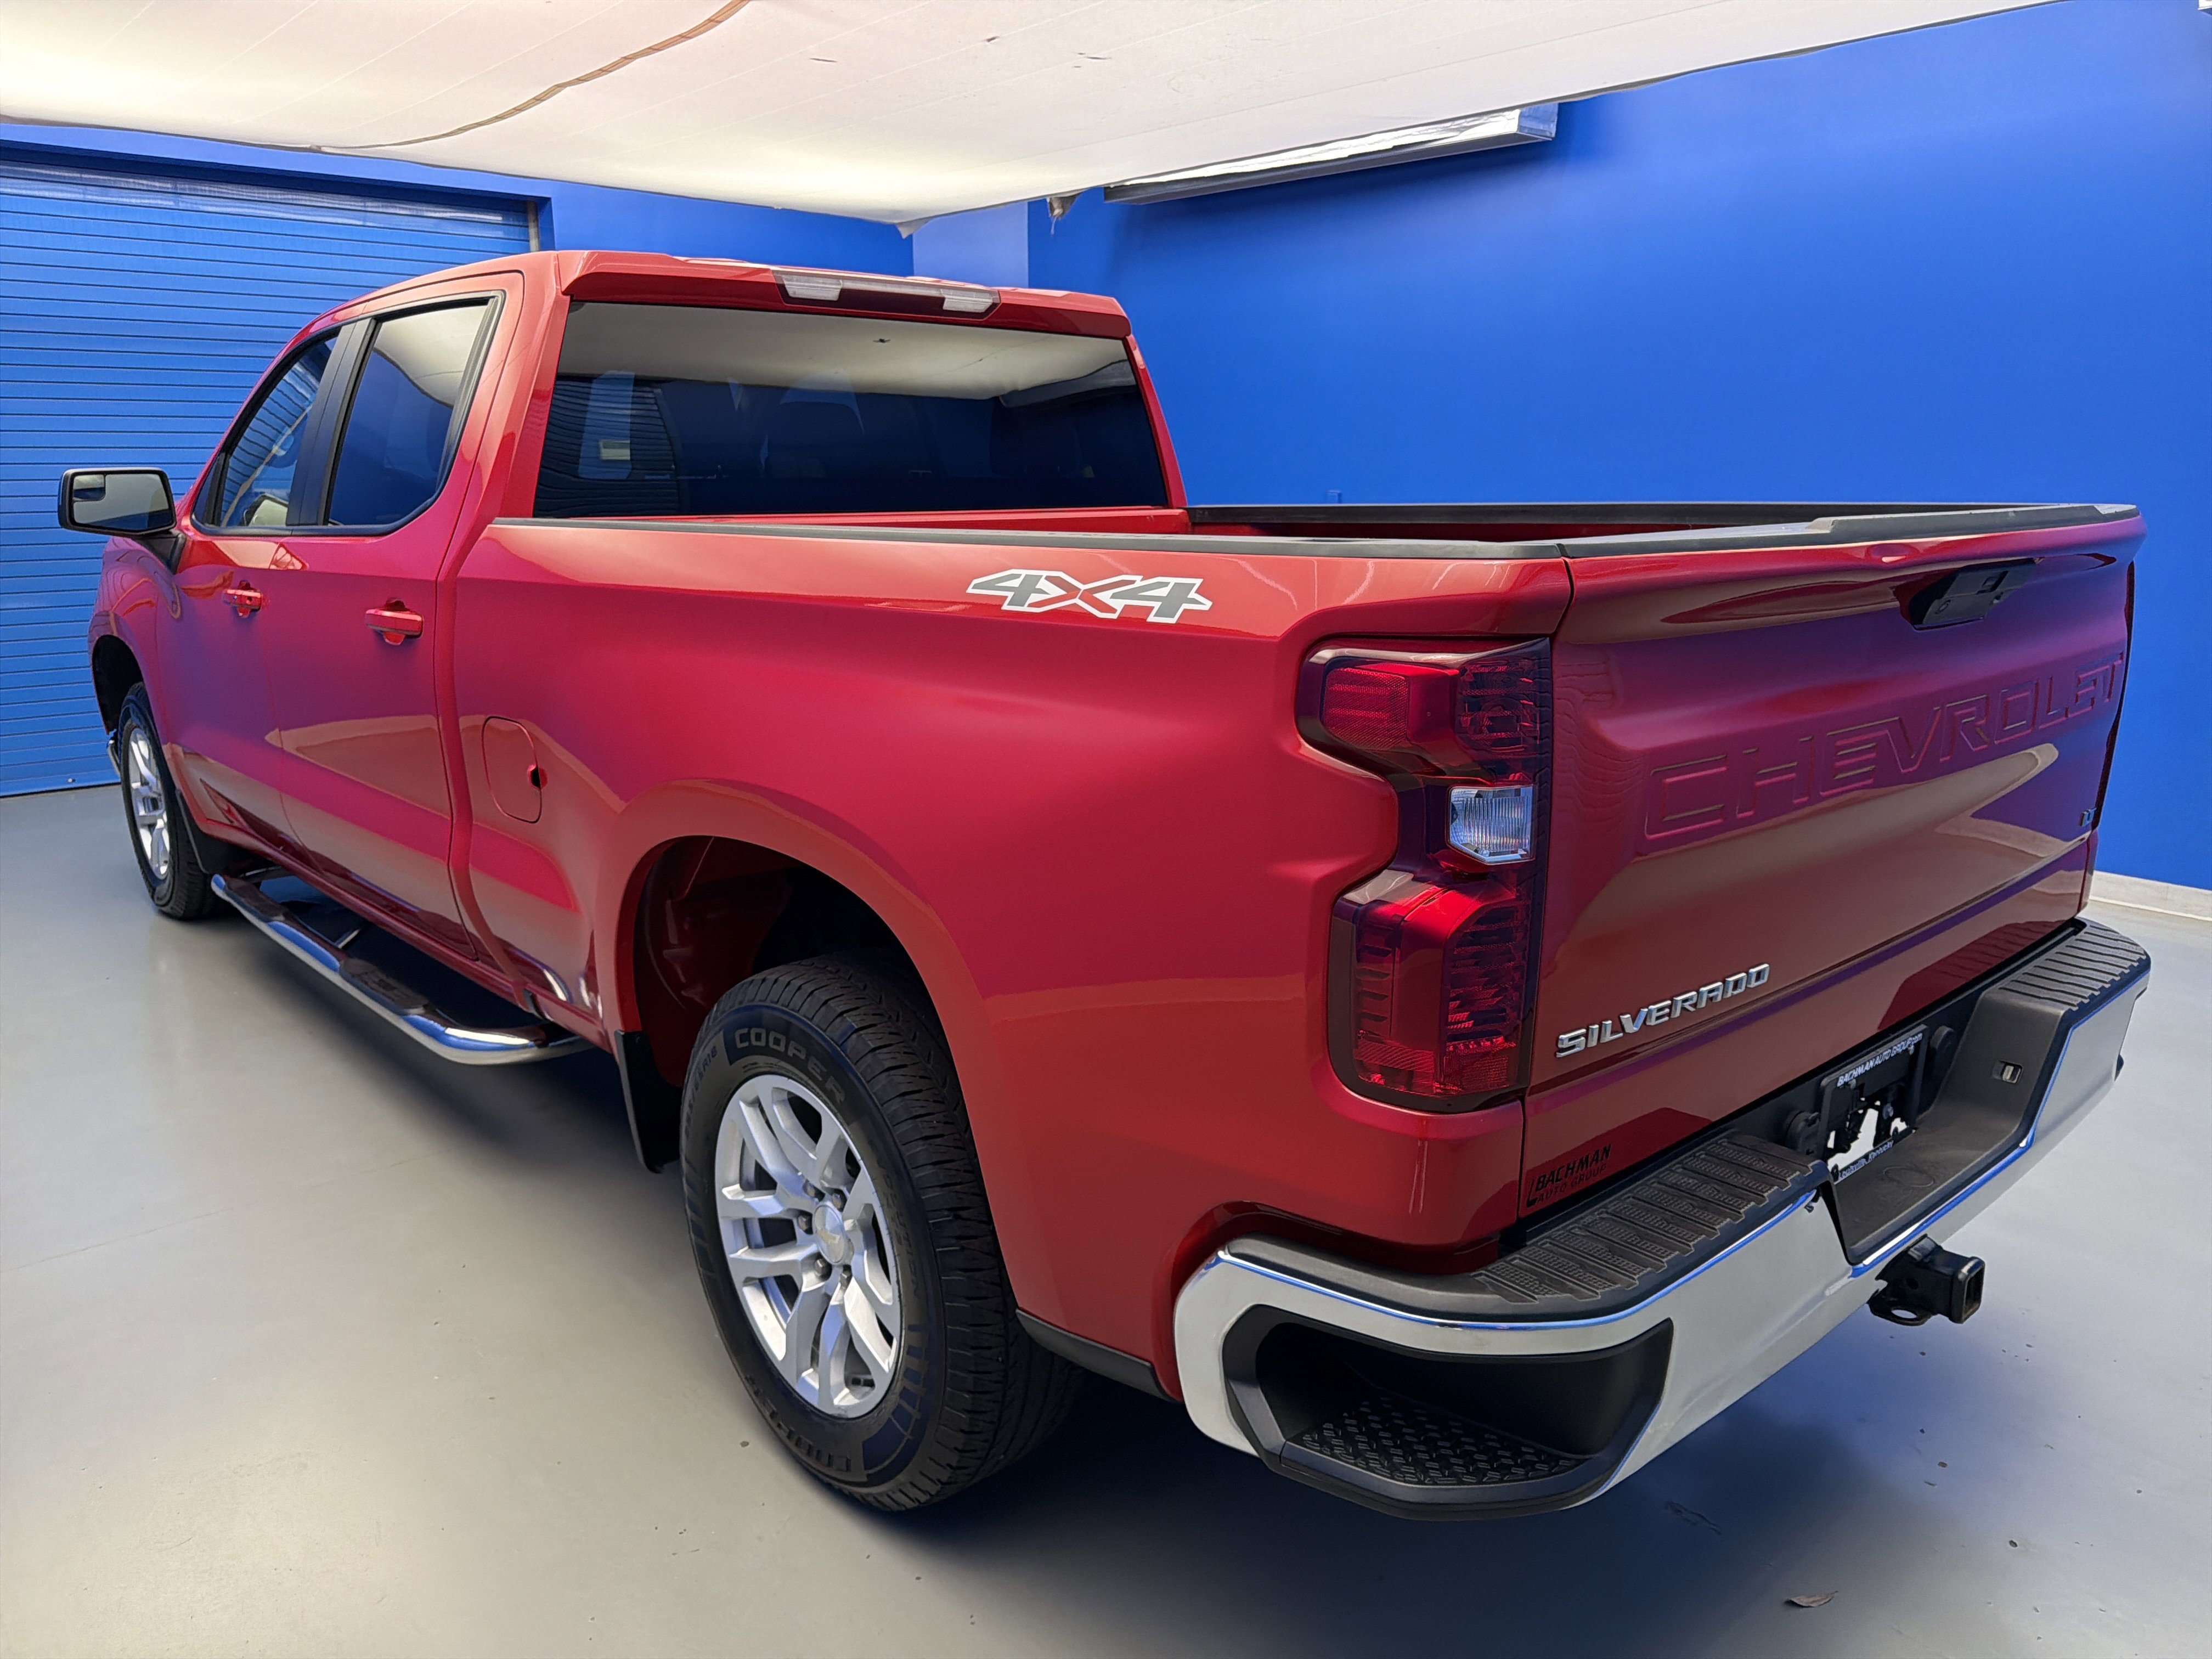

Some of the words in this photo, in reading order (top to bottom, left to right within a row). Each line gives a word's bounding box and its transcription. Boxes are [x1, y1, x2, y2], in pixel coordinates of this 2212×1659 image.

[1645, 651, 2125, 840] CHEVROLET
[1556, 963, 1770, 1058] SILVERADO
[735, 1028, 845, 1104] COOPER
[1536, 1143, 1612, 1192] BACHMAN
[1537, 1182, 1567, 1203] AUTO
[1570, 1163, 1607, 1188] GROUP
